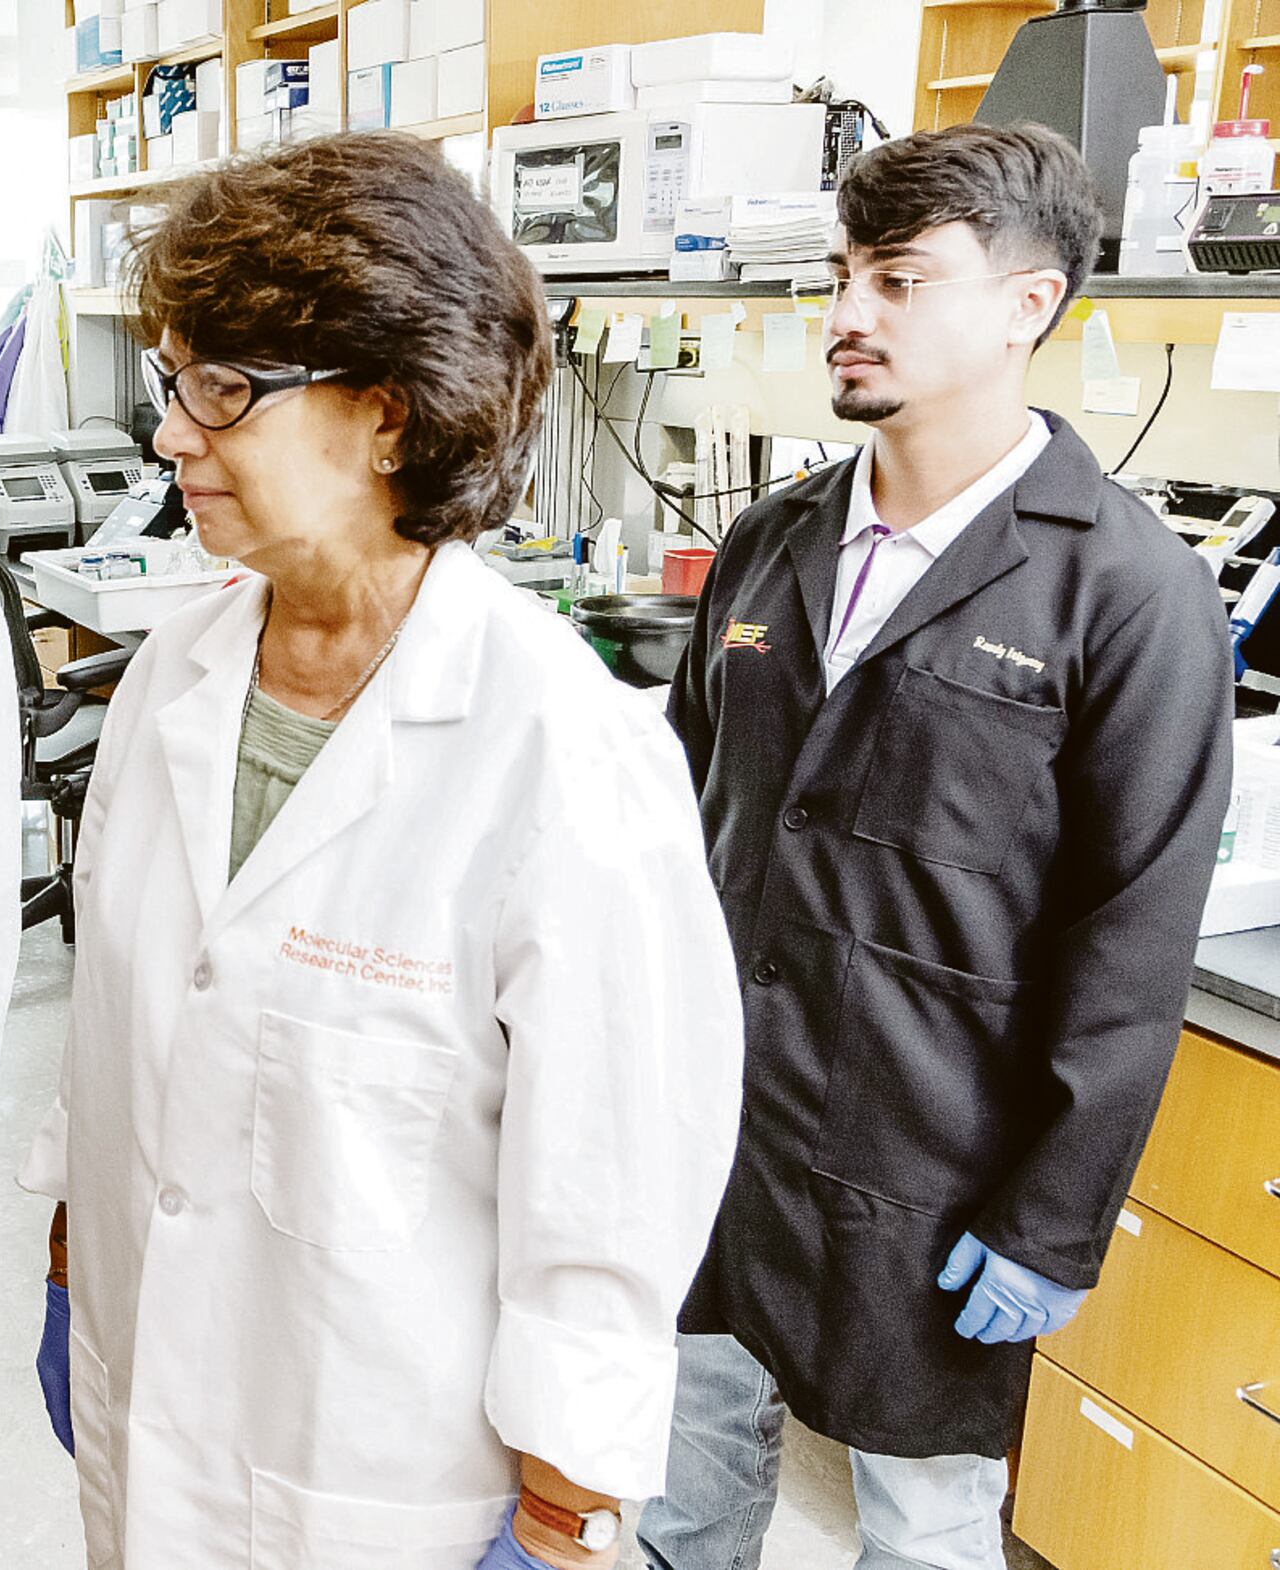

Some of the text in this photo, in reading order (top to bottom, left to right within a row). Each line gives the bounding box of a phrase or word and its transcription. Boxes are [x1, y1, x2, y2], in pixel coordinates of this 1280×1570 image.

[539, 103, 550, 112] 12
[280, 942, 356, 977] Research
[289, 926, 453, 975] Molecular Sciences
